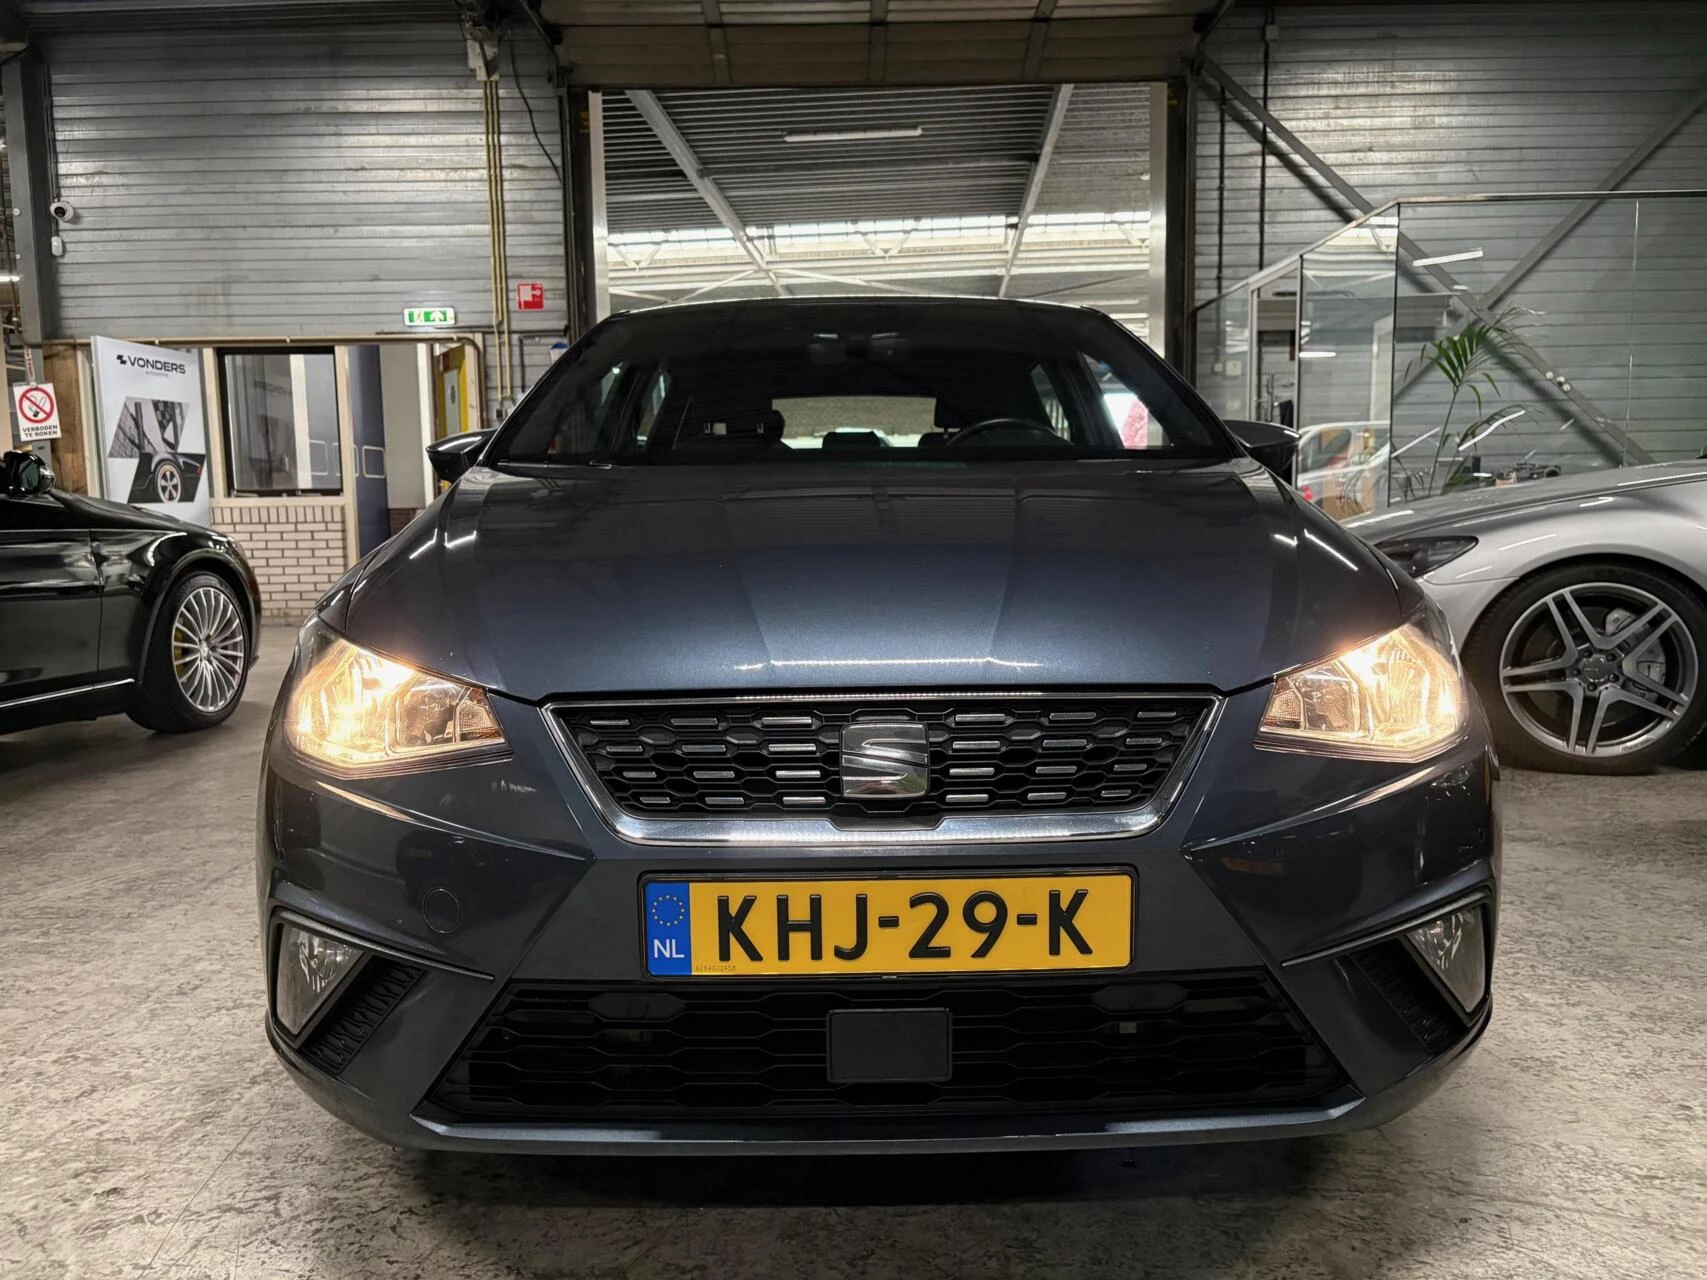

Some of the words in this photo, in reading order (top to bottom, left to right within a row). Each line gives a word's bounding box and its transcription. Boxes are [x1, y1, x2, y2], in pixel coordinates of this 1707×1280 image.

[127, 355, 186, 374] VONDERS
[22, 424, 58, 432] VERBODEN
[717, 889, 1094, 962] KHJ-29-K
[653, 938, 685, 959] NL
